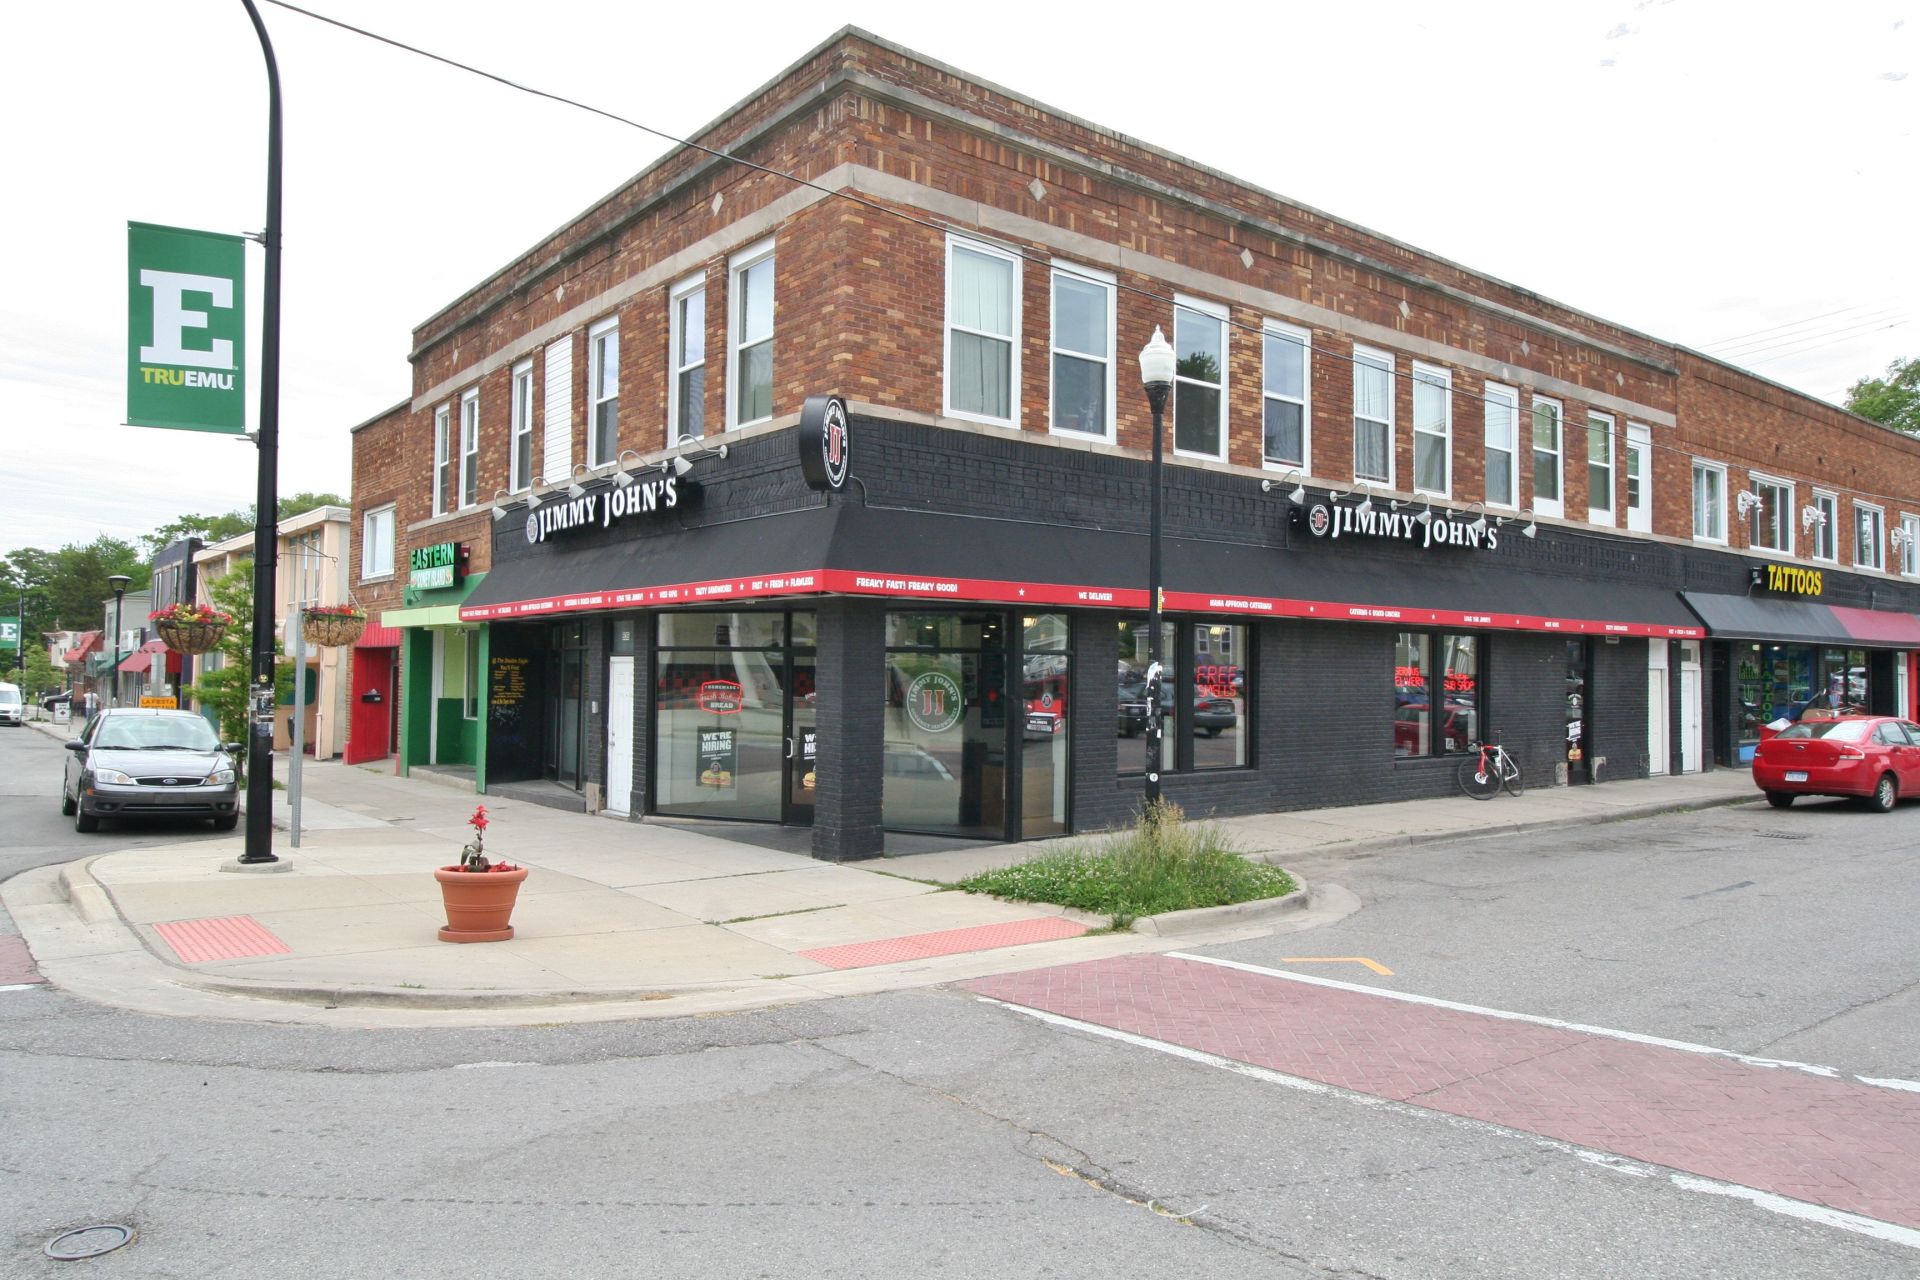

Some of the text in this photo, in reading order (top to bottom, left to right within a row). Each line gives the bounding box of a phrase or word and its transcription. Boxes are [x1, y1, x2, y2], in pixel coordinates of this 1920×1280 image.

[140, 268, 233, 370] E
[539, 477, 677, 542] JIMMY JOHN'S
[1332, 505, 1497, 549] JIMMY JOHN'S
[410, 542, 455, 570] EASTERN
[856, 577, 957, 593] FREAKY FAST! FREAKY GOOD!
[1768, 564, 1822, 596] TATTOOS
[1078, 591, 1113, 601] WE DELIVER!
[1, 623, 17, 639] E
[1196, 665, 1239, 684] FREE
[1199, 683, 1237, 698] SMELLS
[702, 731, 732, 741] WE'RE
[701, 740, 732, 752] HIRING
